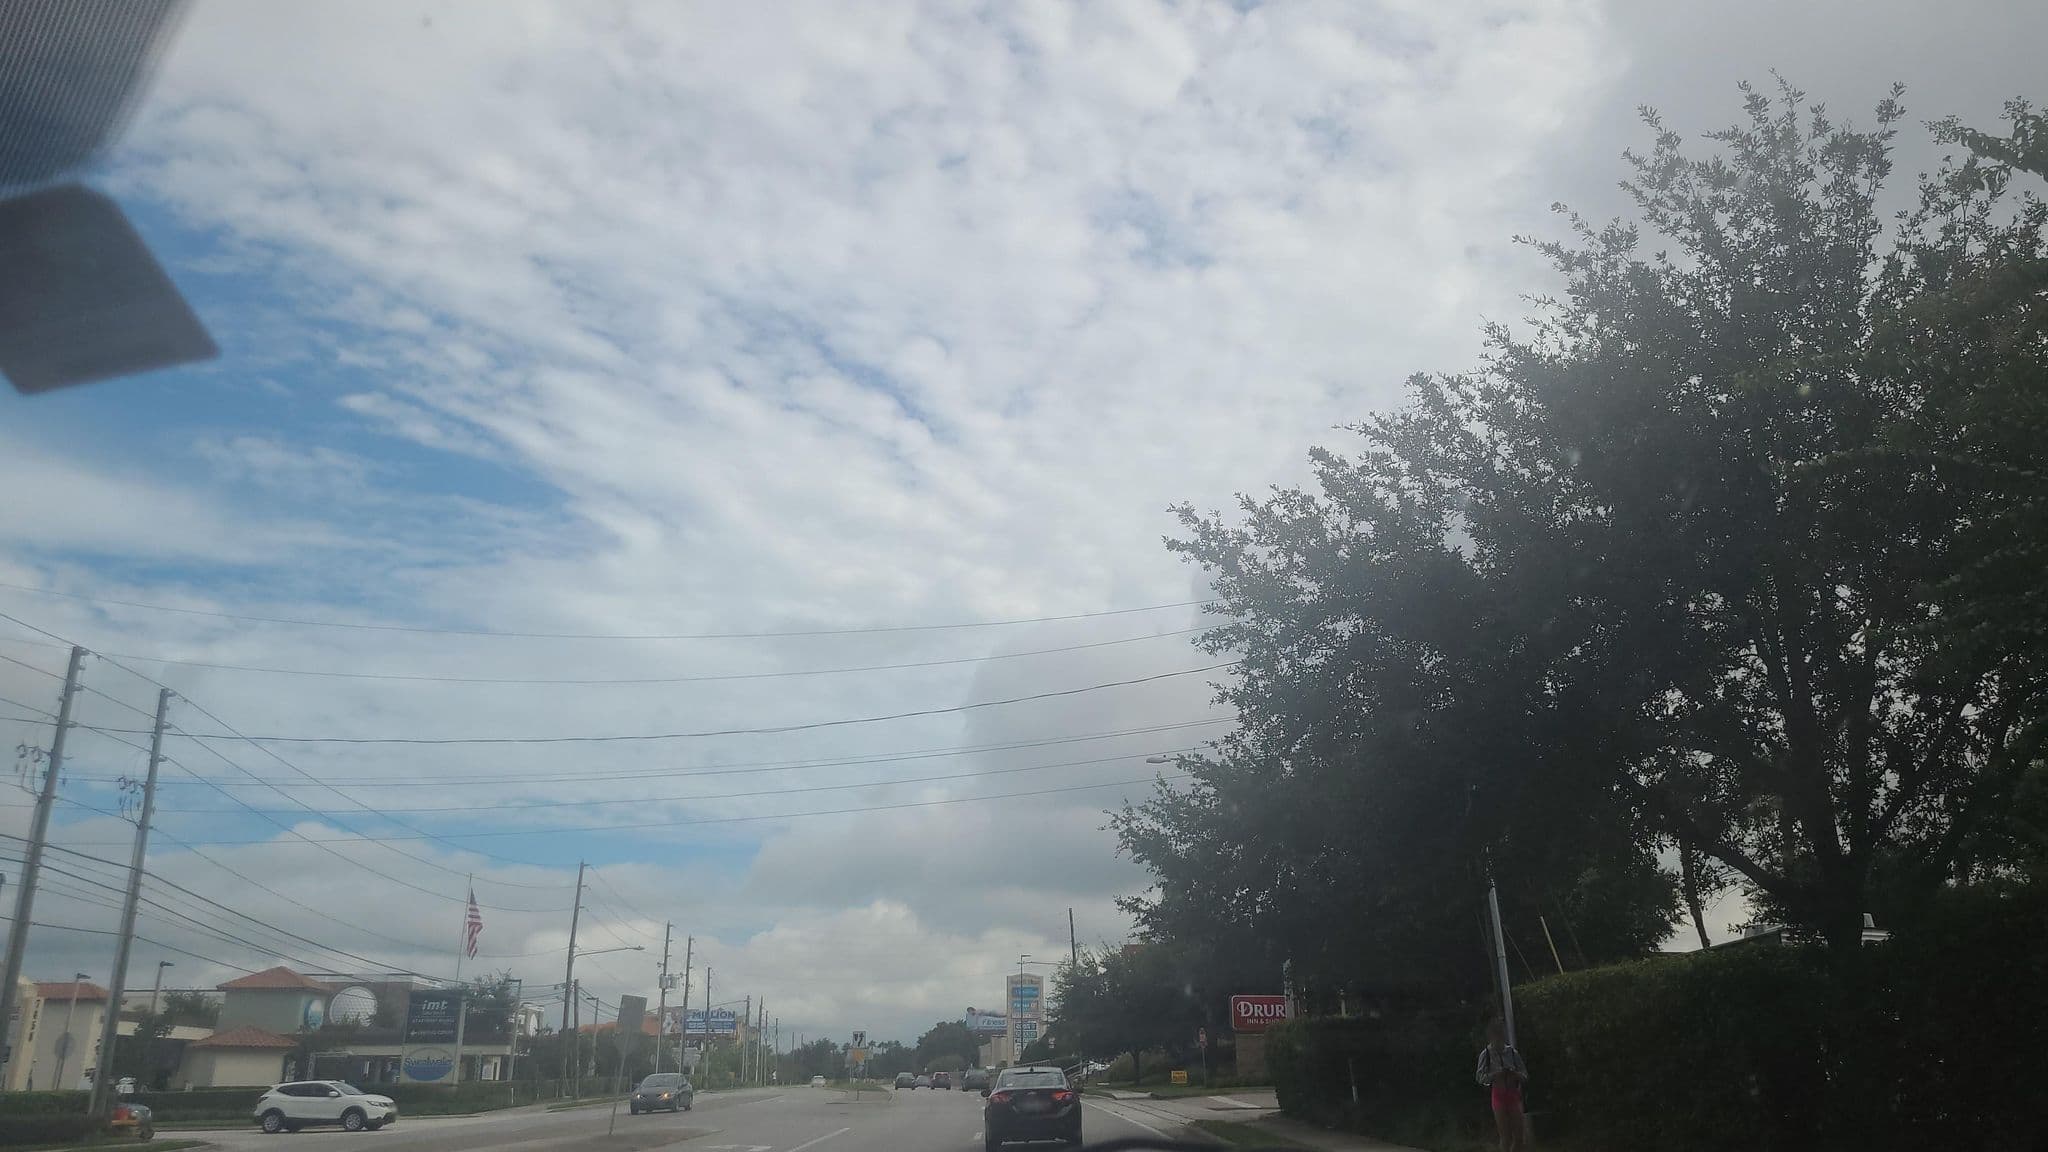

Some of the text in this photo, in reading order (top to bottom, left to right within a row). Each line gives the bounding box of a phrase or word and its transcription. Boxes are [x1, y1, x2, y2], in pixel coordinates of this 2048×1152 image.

[422, 1000, 448, 1010] imt
[1236, 1001, 1286, 1017] DRUR
[692, 1010, 735, 1019] MILION
